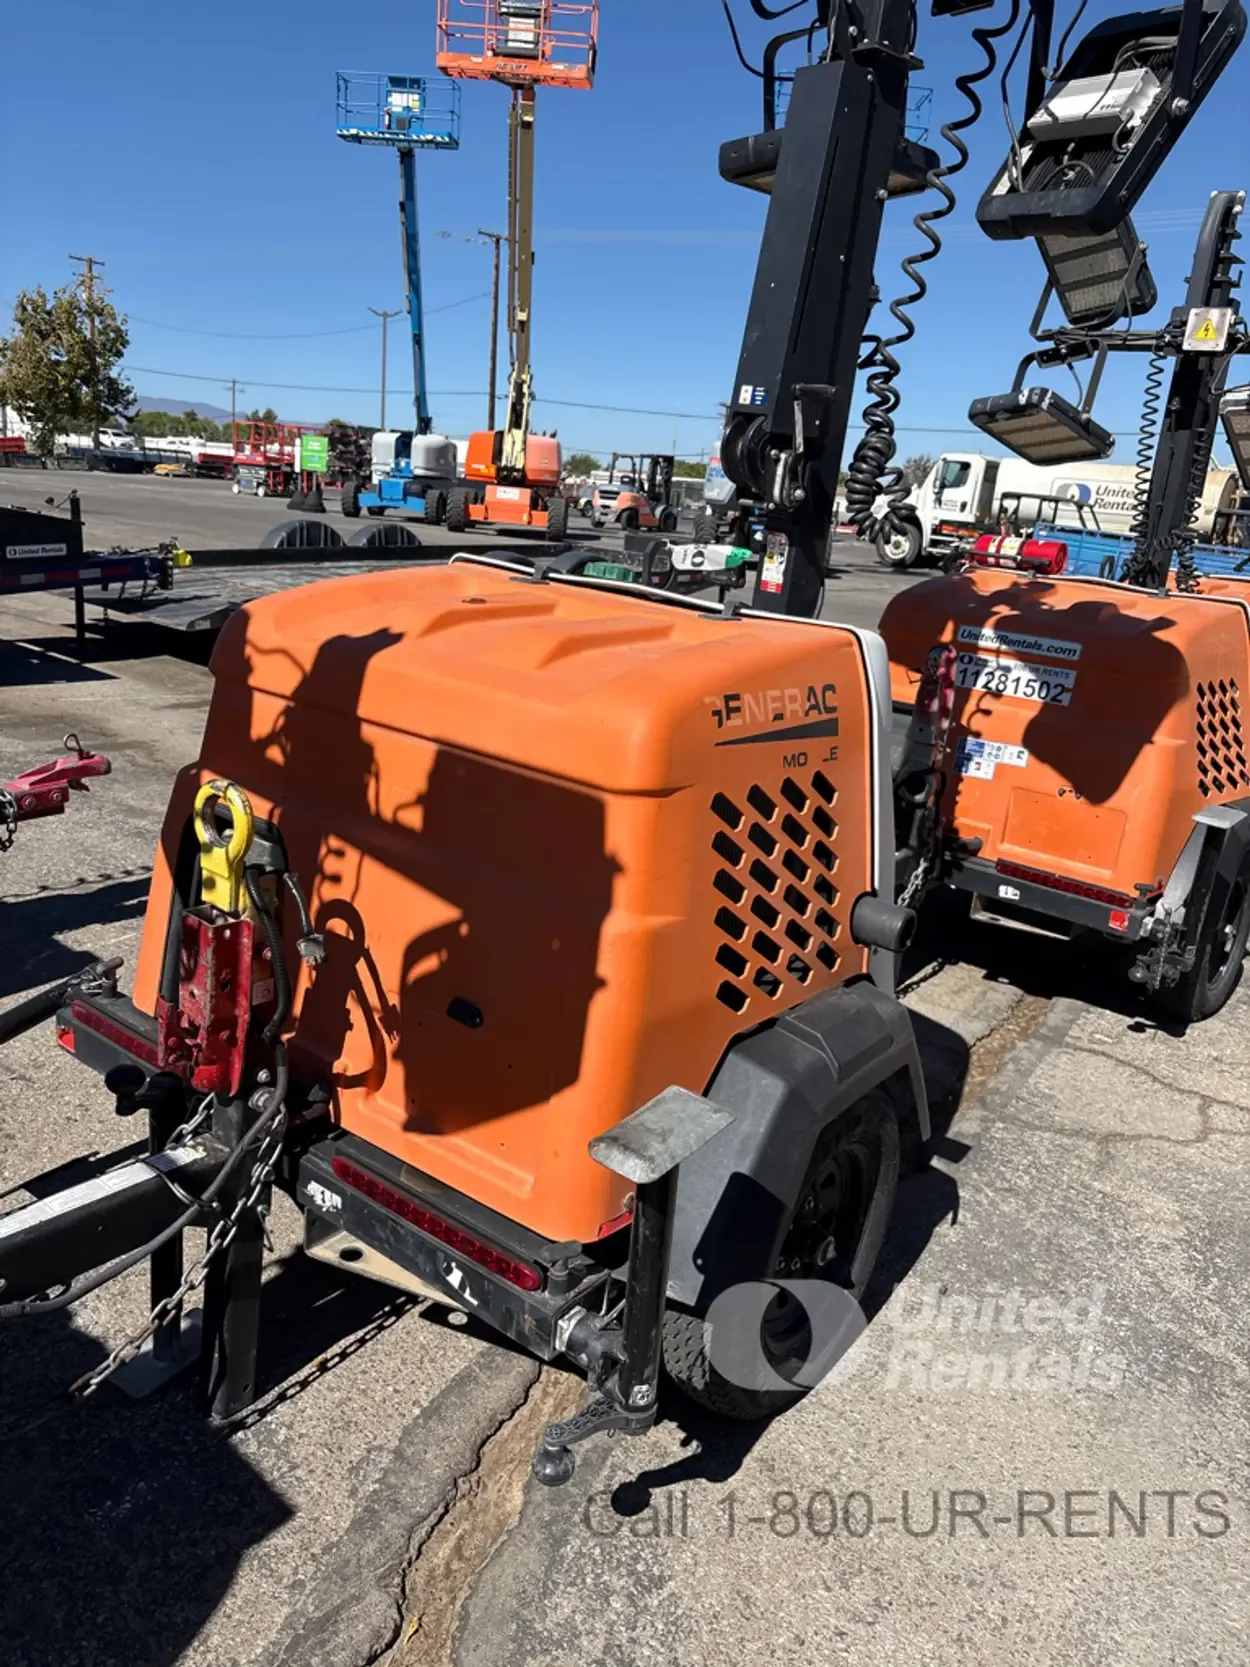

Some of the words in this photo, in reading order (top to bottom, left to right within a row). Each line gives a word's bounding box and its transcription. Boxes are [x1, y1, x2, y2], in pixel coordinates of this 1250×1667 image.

[1095, 484, 1137, 499] Unite
[1093, 498, 1137, 512] Renta
[960, 628, 1078, 657] UnitedRentals.com
[958, 667, 1066, 704] 11281502
